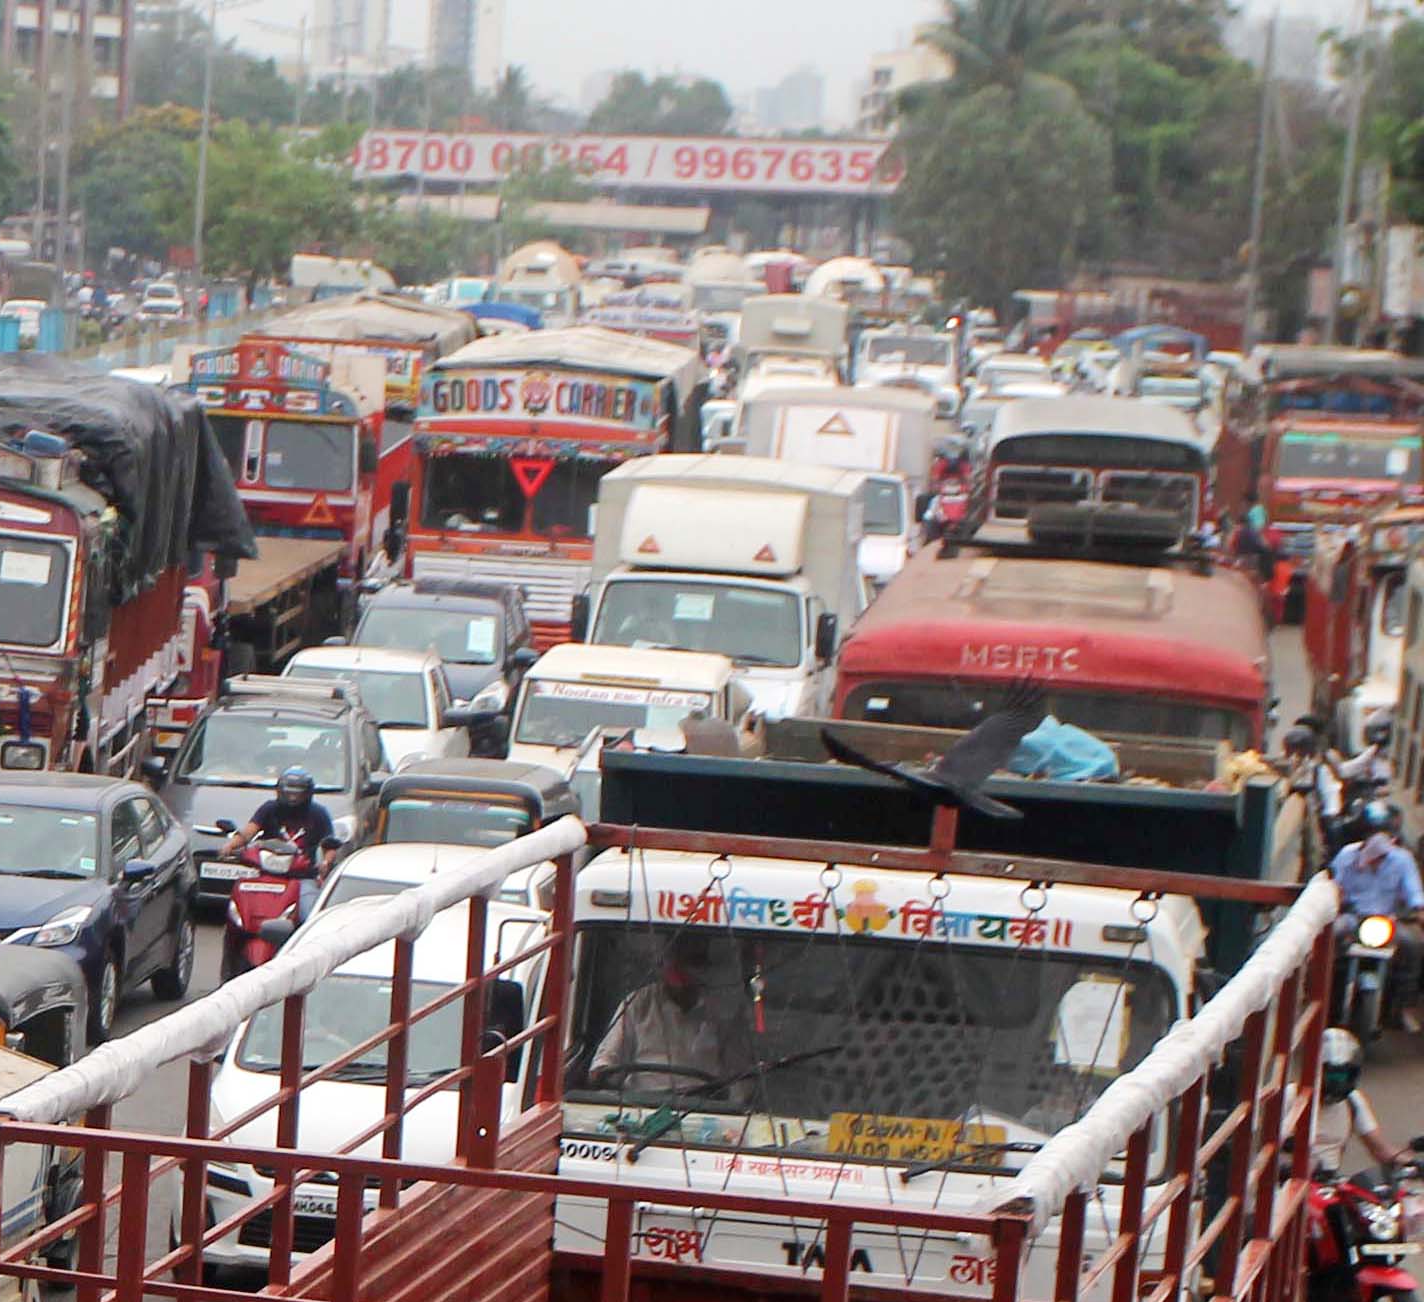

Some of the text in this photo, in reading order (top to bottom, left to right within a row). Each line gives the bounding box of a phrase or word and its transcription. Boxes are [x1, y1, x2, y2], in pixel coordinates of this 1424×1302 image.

[433, 379, 637, 422] GOODS CARRIER
[961, 643, 1080, 672] MSRTC
